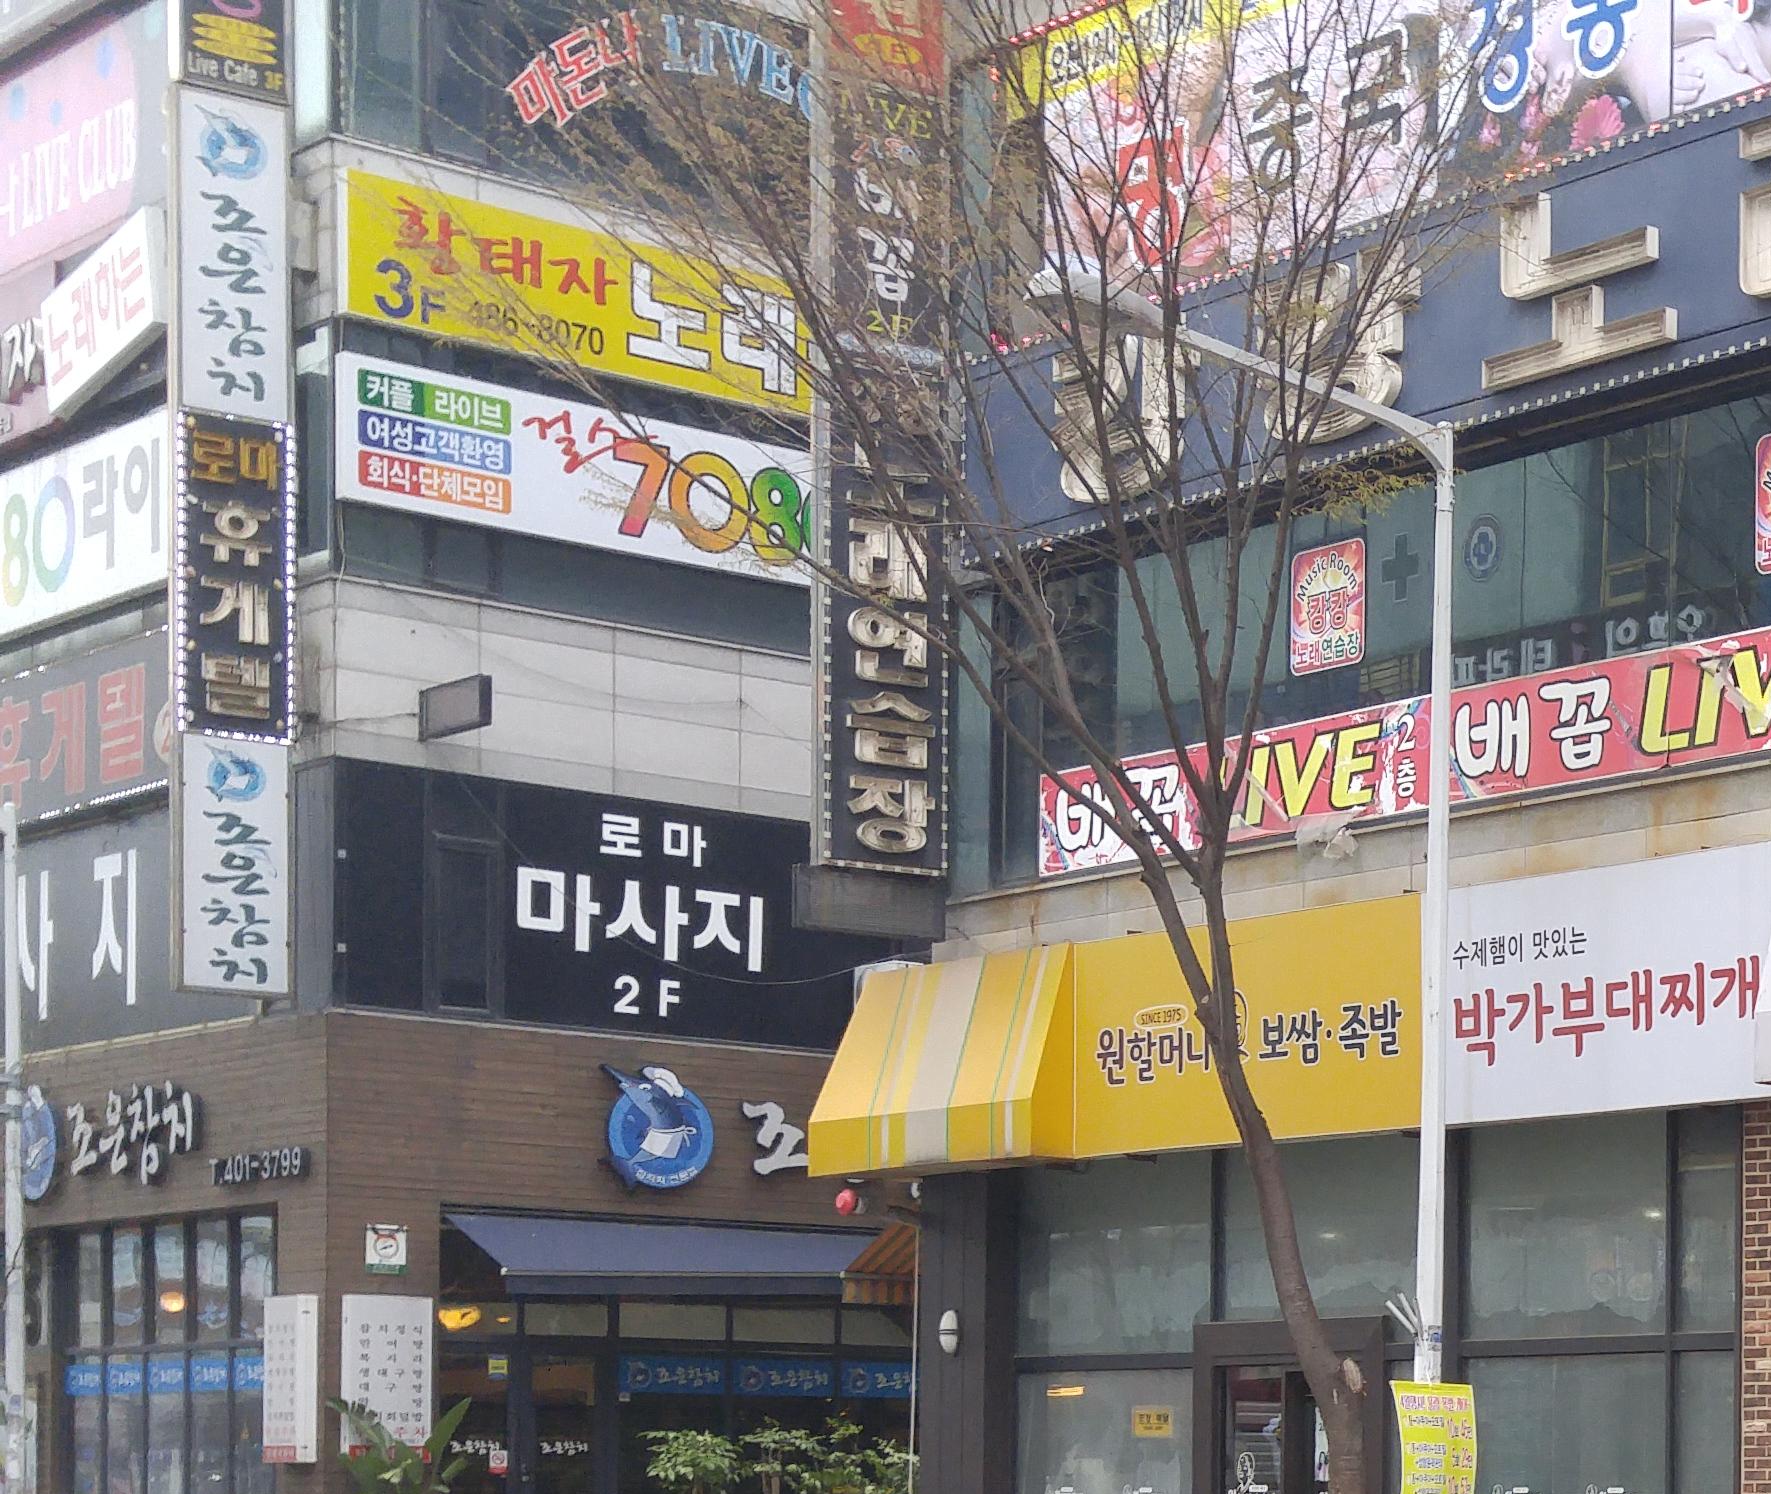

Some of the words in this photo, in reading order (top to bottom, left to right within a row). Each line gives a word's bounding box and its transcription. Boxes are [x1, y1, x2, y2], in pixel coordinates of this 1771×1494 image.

[188, 51, 218, 79] Live
[224, 59, 259, 87] Cafe
[506, 11, 640, 127] 마돈나
[662, 14, 797, 104] LIVE
[22, 126, 72, 229] LIVE
[78, 100, 137, 200] CLUB
[394, 197, 618, 305] 황태자
[199, 190, 268, 402] 조은참치
[374, 259, 447, 324] 3F
[366, 373, 414, 411] 커플
[435, 391, 503, 428] 라이브
[191, 431, 281, 491] 로마
[366, 420, 504, 467] 여성고객환영
[613, 437, 811, 565] 708
[1297, 557, 1330, 602] Music
[1330, 551, 1359, 591] Room
[199, 501, 273, 719] 휴게텔
[1308, 586, 1350, 634] 캉캉
[1294, 631, 1361, 667] 노래연습장
[1453, 675, 1613, 782] 배꼽
[1224, 719, 1382, 832] IVE
[601, 811, 706, 868] 로마
[201, 810, 272, 985] 조은참치
[516, 867, 764, 974] 마사지
[1453, 933, 1524, 969] 수제햄이
[1533, 926, 1588, 960] 맛있는
[614, 975, 681, 1018] 2F
[1140, 1010, 1162, 1026] SINCE
[1162, 1008, 1182, 1023] 1975
[1453, 955, 1759, 1066] 박가부대찌개
[1097, 1028, 1209, 1084] 원할머니
[67, 1079, 193, 1185] 조은참치
[209, 1146, 302, 1185] T.401-3799
